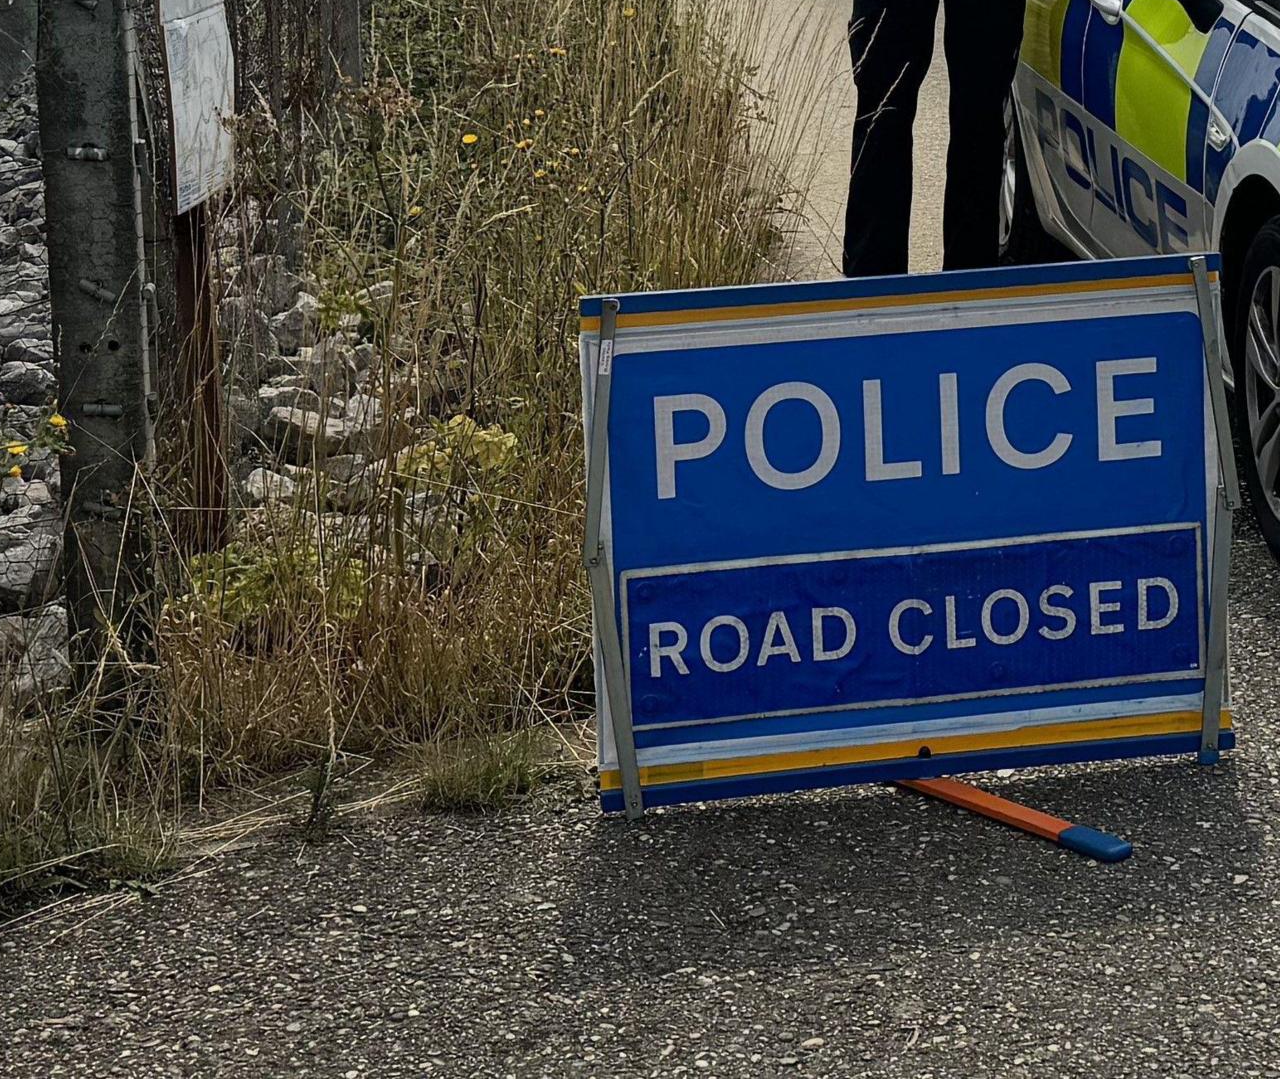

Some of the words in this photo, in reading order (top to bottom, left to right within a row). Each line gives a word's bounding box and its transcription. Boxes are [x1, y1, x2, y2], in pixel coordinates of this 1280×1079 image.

[1035, 87, 1189, 256] POLICE
[652, 357, 1162, 500] POLICE
[649, 606, 857, 678] ROAD
[888, 576, 1180, 656] CLOSED
